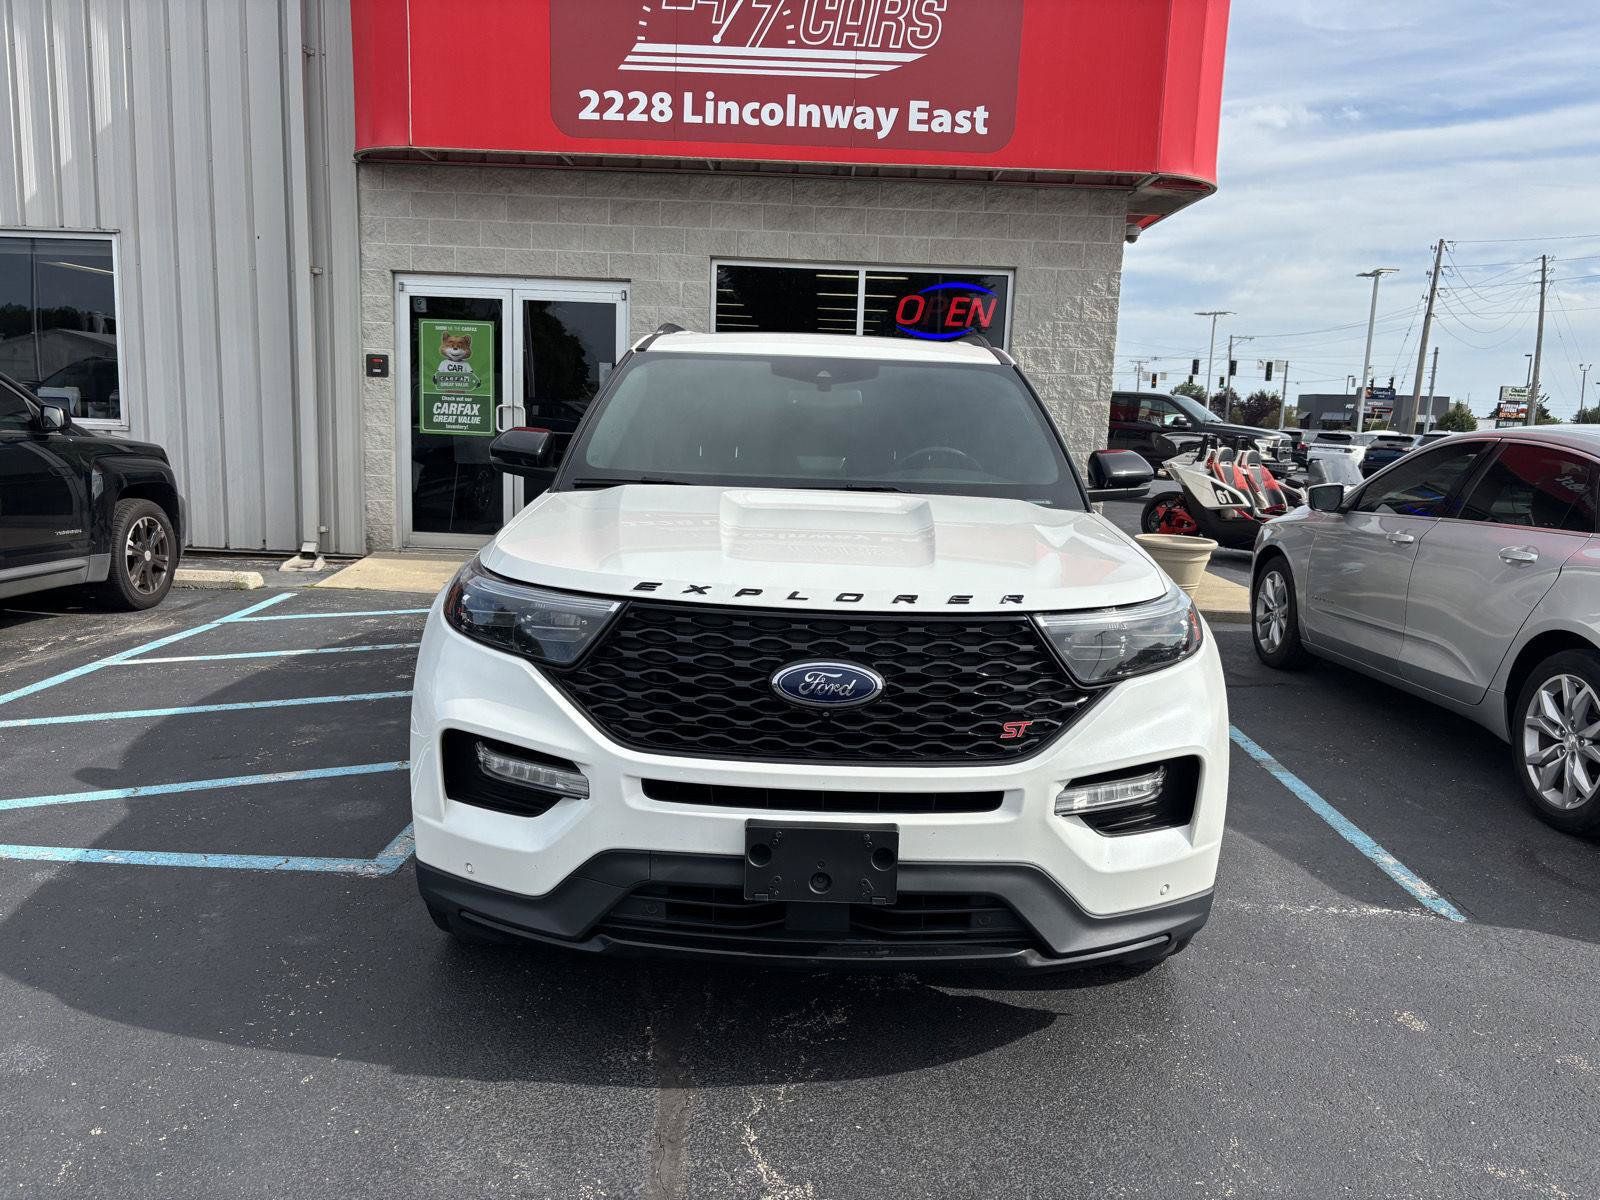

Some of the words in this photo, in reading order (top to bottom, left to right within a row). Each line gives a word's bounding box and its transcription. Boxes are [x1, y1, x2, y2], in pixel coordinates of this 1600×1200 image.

[800, 0, 948, 49] CARS
[577, 89, 673, 123] 2228
[683, 92, 898, 140] Lincolnway
[908, 100, 989, 135] East
[895, 294, 998, 328] OPEN
[432, 414, 458, 423] GREAT
[458, 416, 482, 424] VALUE
[433, 402, 480, 416] CARFAX
[1216, 489, 1233, 504] 61
[633, 581, 1026, 605] EXPLORER
[798, 670, 857, 698] Ford
[1001, 720, 1034, 739] ST
